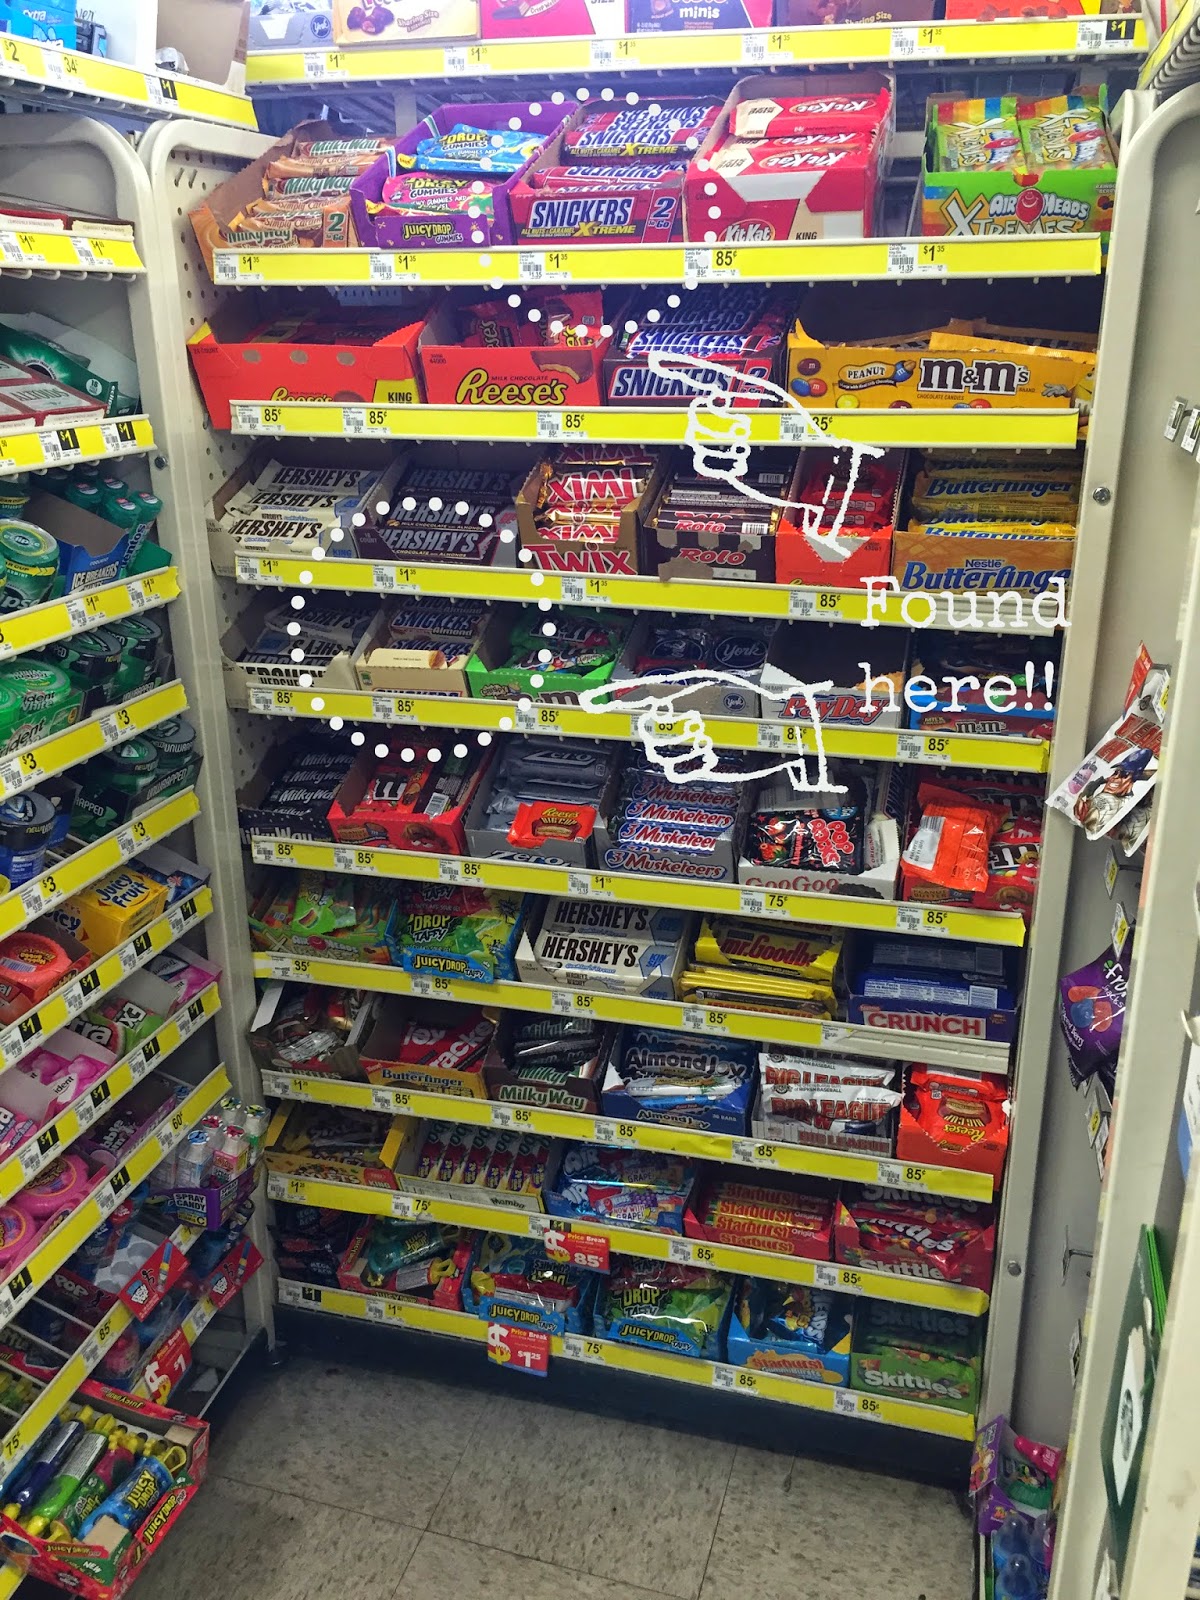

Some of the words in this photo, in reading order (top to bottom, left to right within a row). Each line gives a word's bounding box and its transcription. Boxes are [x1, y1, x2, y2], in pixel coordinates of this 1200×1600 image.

[679, 5, 720, 20] minis
[874, 11, 892, 21] Size
[1111, 21, 1127, 38] $1
[579, 129, 672, 145] SNICKERS
[409, 188, 457, 198] GUMMIES
[531, 198, 633, 228] SNICKERS
[651, 198, 675, 218] 2
[328, 213, 345, 232] 2
[576, 222, 636, 236] XTREME
[796, 231, 817, 240] KING
[716, 250, 737, 266] 85¢
[635, 332, 747, 350] SNICKERS
[847, 367, 886, 379] PEANUT
[456, 368, 569, 404] Reese's
[388, 392, 412, 402] KING
[264, 408, 281, 422] 85¢
[369, 410, 387, 425] 85¢
[565, 414, 585, 429] 85¢
[119, 422, 131, 440] $1
[60, 430, 74, 448] $1
[820, 594, 841, 608] 85¢
[722, 642, 760, 658] York
[277, 692, 293, 703] 85¢
[397, 700, 415, 712] 85¢
[118, 709, 130, 725] $3
[541, 710, 559, 723] 85¢
[928, 738, 949, 752] 85¢
[23, 752, 37, 769] $3
[629, 804, 641, 815] 3
[643, 804, 733, 826] Musketeers
[134, 822, 146, 836] $3
[622, 825, 636, 837] 3
[608, 852, 622, 864] 3
[623, 854, 723, 877] Musketeers
[43, 876, 56, 892] $3
[96, 874, 133, 901] Juicy
[112, 882, 149, 908] Fruit
[768, 895, 787, 907] 75¢
[413, 915, 450, 932] DROP
[555, 901, 649, 931] HERSHEY'S
[926, 911, 948, 925] 85¢
[542, 936, 639, 967] HERSHEY'S
[82, 975, 95, 990] $1
[577, 996, 593, 1007] 85¢
[21, 1018, 34, 1034] $1
[709, 1013, 727, 1024] 85¢
[868, 1013, 982, 1036] CRUNCH
[382, 1069, 464, 1087] Butterfinger
[41, 1128, 53, 1144] $1
[619, 1125, 637, 1137] 85¢
[906, 1168, 926, 1180] 85¢
[175, 1193, 204, 1202] SPRAY
[176, 1200, 206, 1213] CANDY
[567, 1233, 583, 1241] Price
[584, 1235, 605, 1245] Break
[574, 1253, 603, 1267] 85¢
[697, 1248, 714, 1260] 85¢
[12, 1271, 26, 1289] $1
[843, 1272, 861, 1284] 85¢
[511, 1329, 528, 1338] Price
[529, 1331, 548, 1342] Break
[739, 1375, 756, 1386] 85¢
[864, 1370, 964, 1400] Skittles
[862, 1399, 879, 1411] 85¢
[127, 1470, 156, 1504] JUICY
